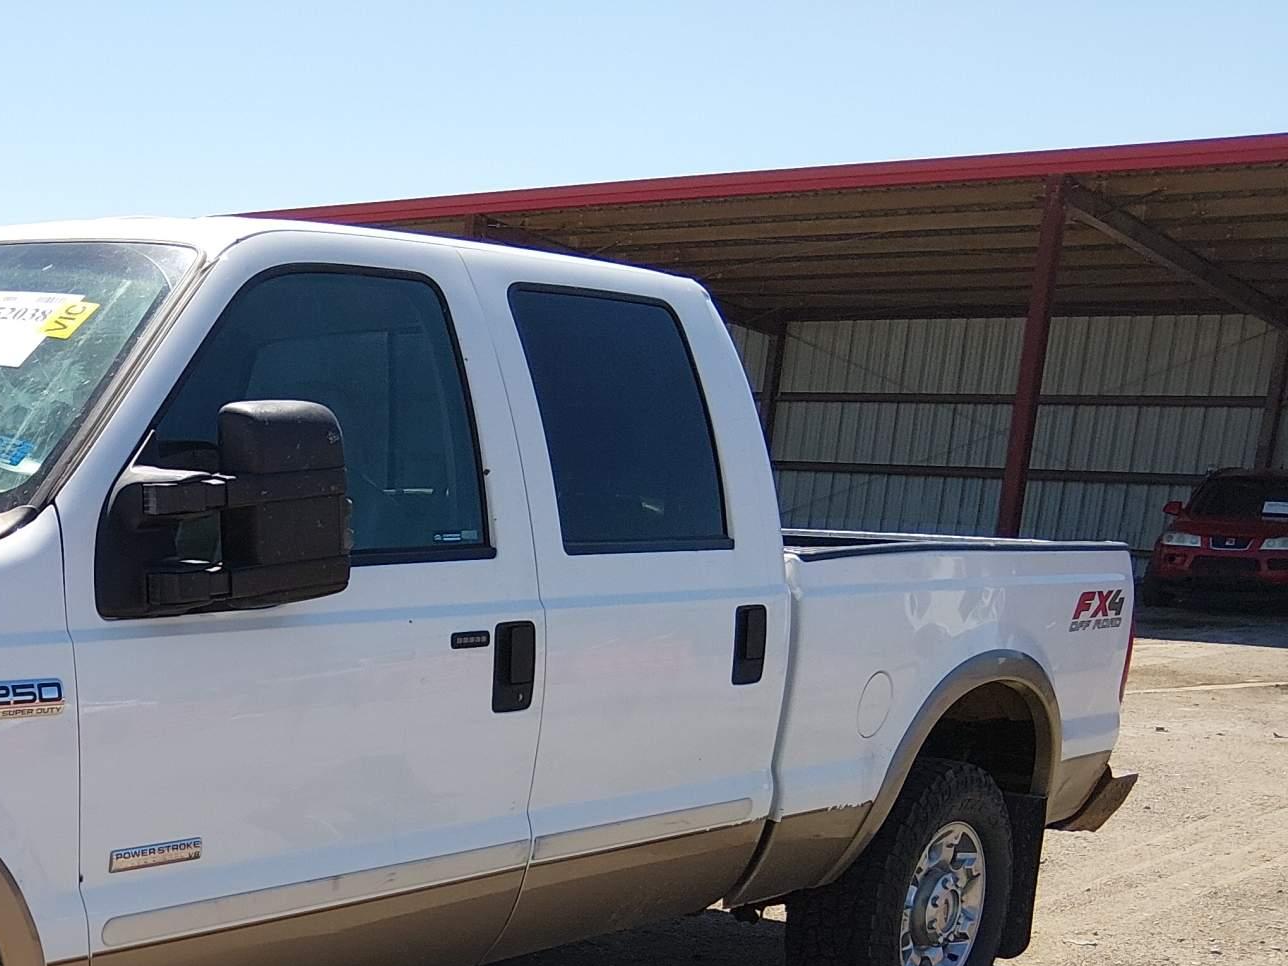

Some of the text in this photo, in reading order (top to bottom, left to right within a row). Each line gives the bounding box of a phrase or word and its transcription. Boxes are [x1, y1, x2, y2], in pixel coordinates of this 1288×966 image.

[45, 304, 88, 335] VIC
[1072, 589, 1125, 620] FX4
[1068, 617, 1122, 632] OFF ROAD
[1, 708, 34, 717] SUPER
[35, 706, 62, 716] DUTY
